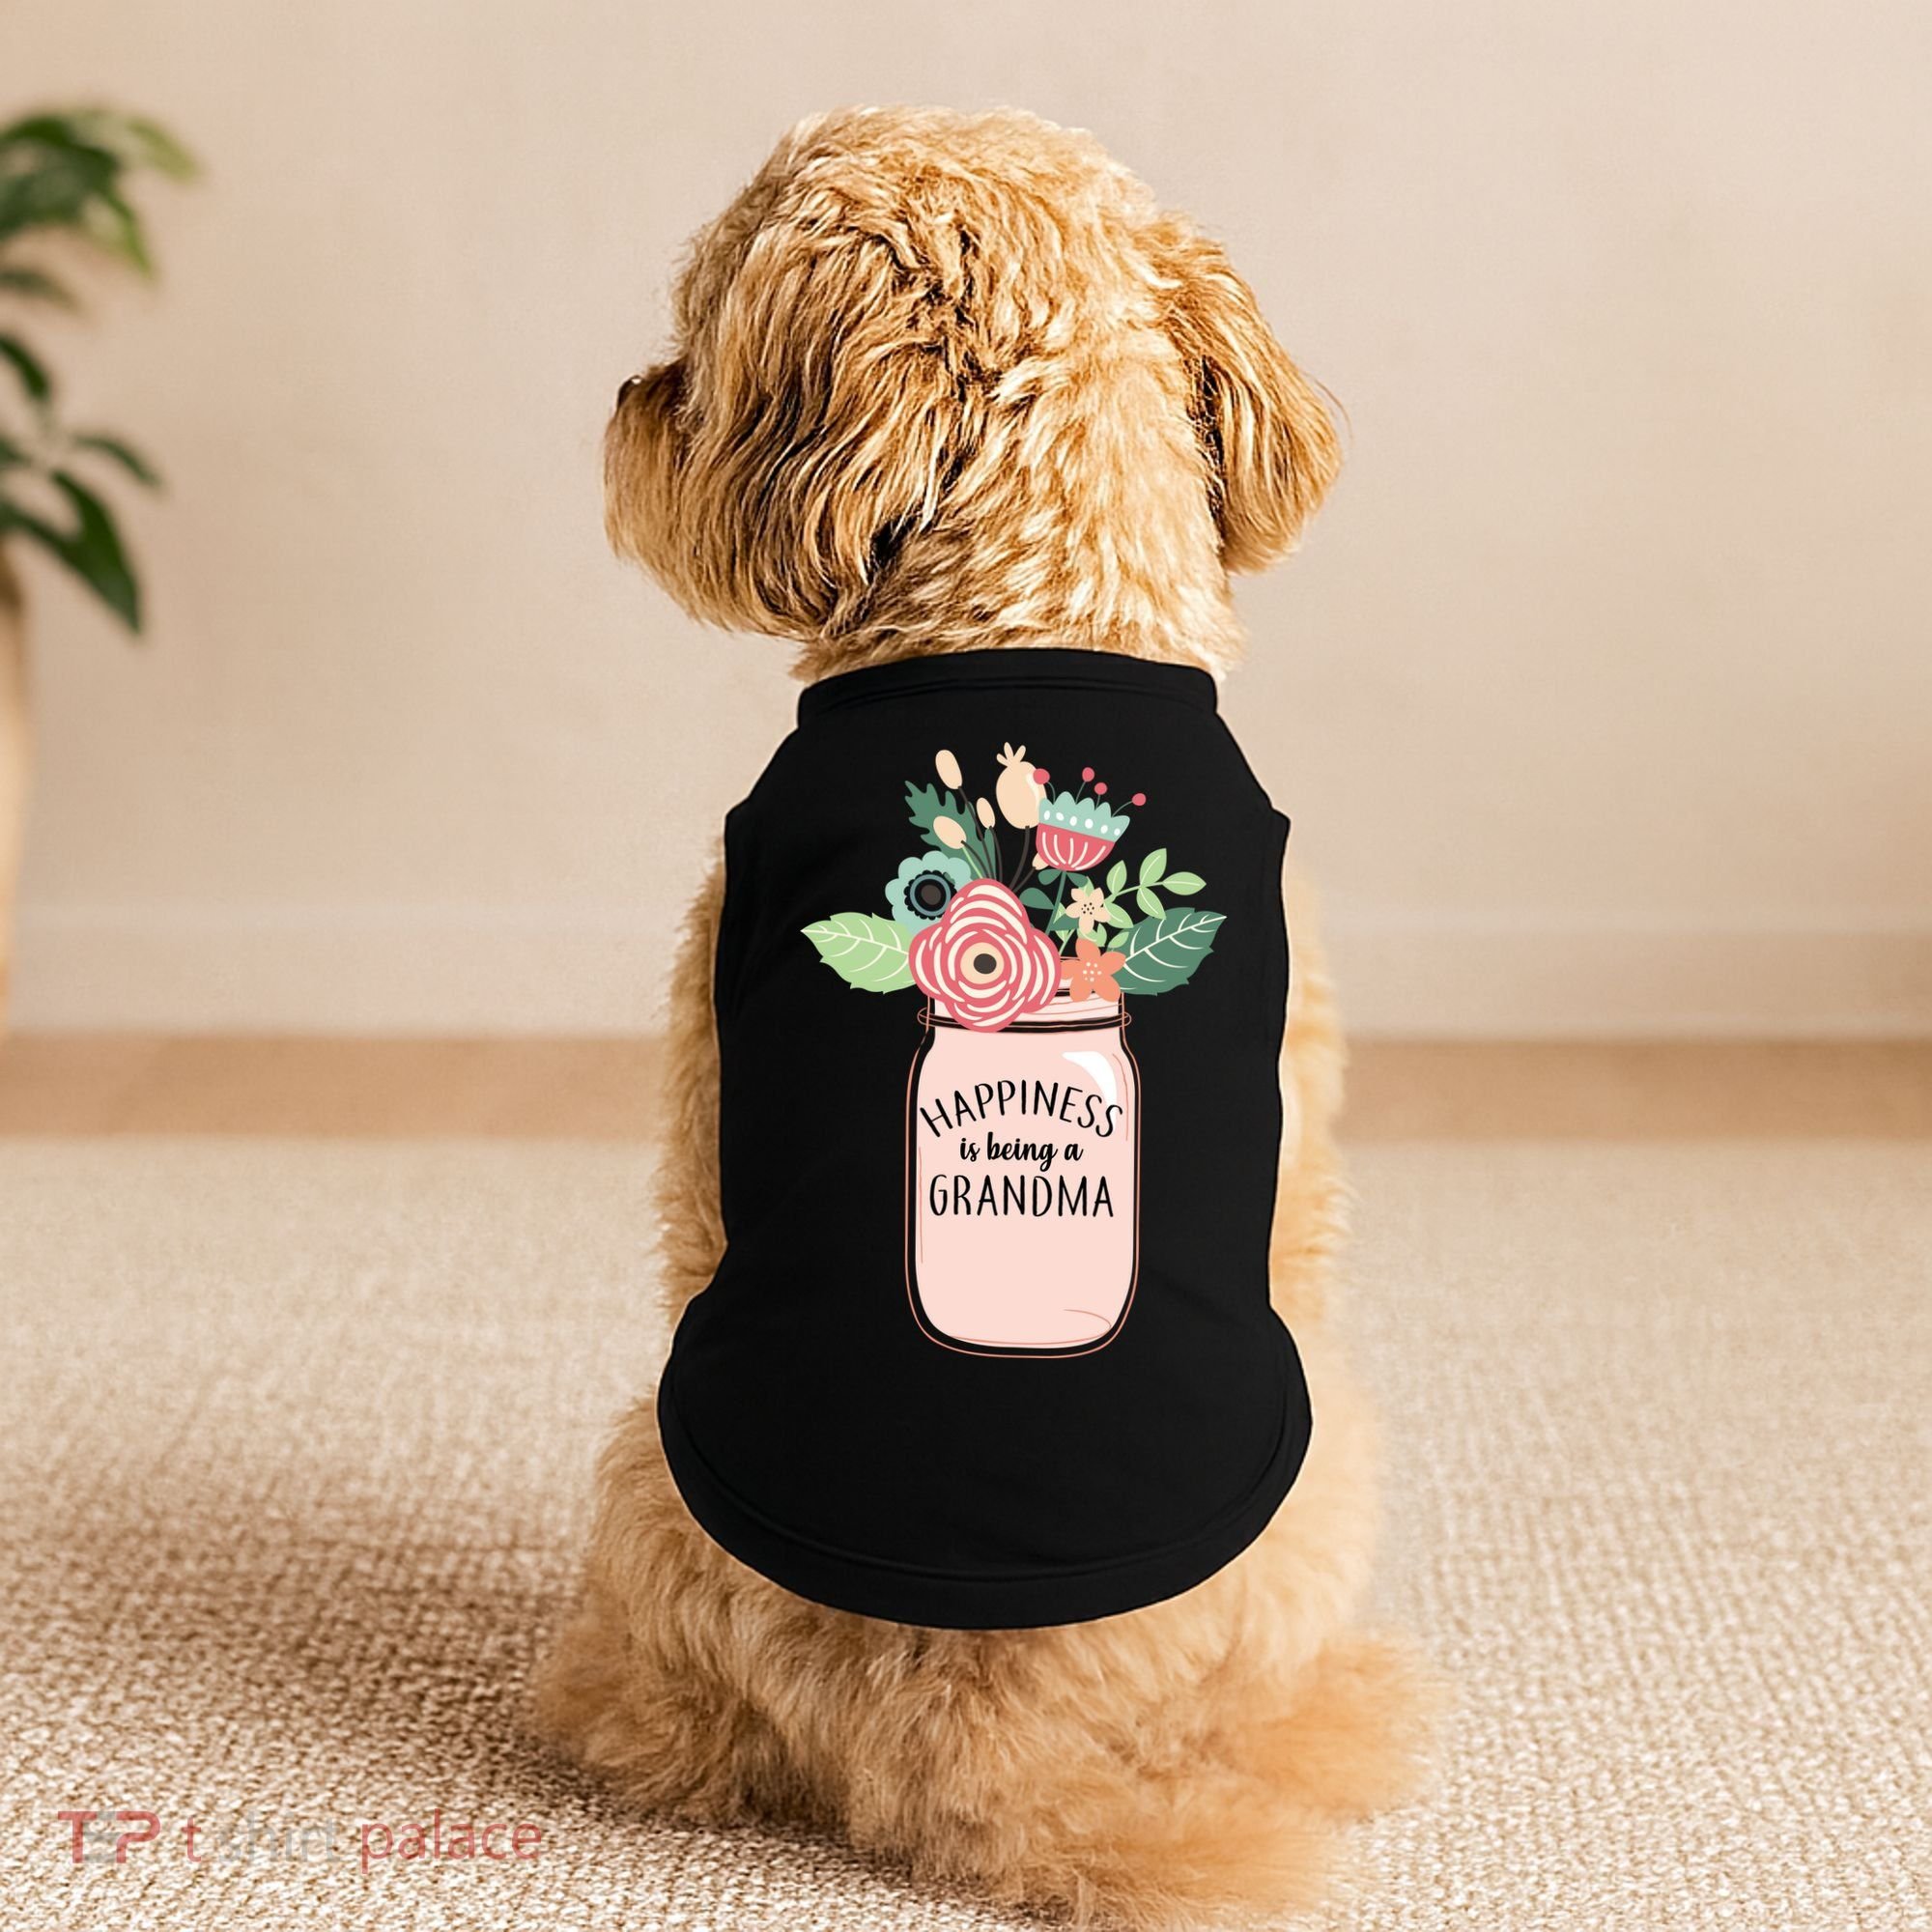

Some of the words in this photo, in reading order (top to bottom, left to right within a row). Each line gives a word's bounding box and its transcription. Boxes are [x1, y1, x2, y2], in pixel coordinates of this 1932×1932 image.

[920, 1079, 1123, 1138] HAPPINESS
[959, 1137, 980, 1162] is
[986, 1131, 1059, 1172] being
[1064, 1143, 1084, 1161] a
[929, 1174, 1114, 1217] GRANDMA
